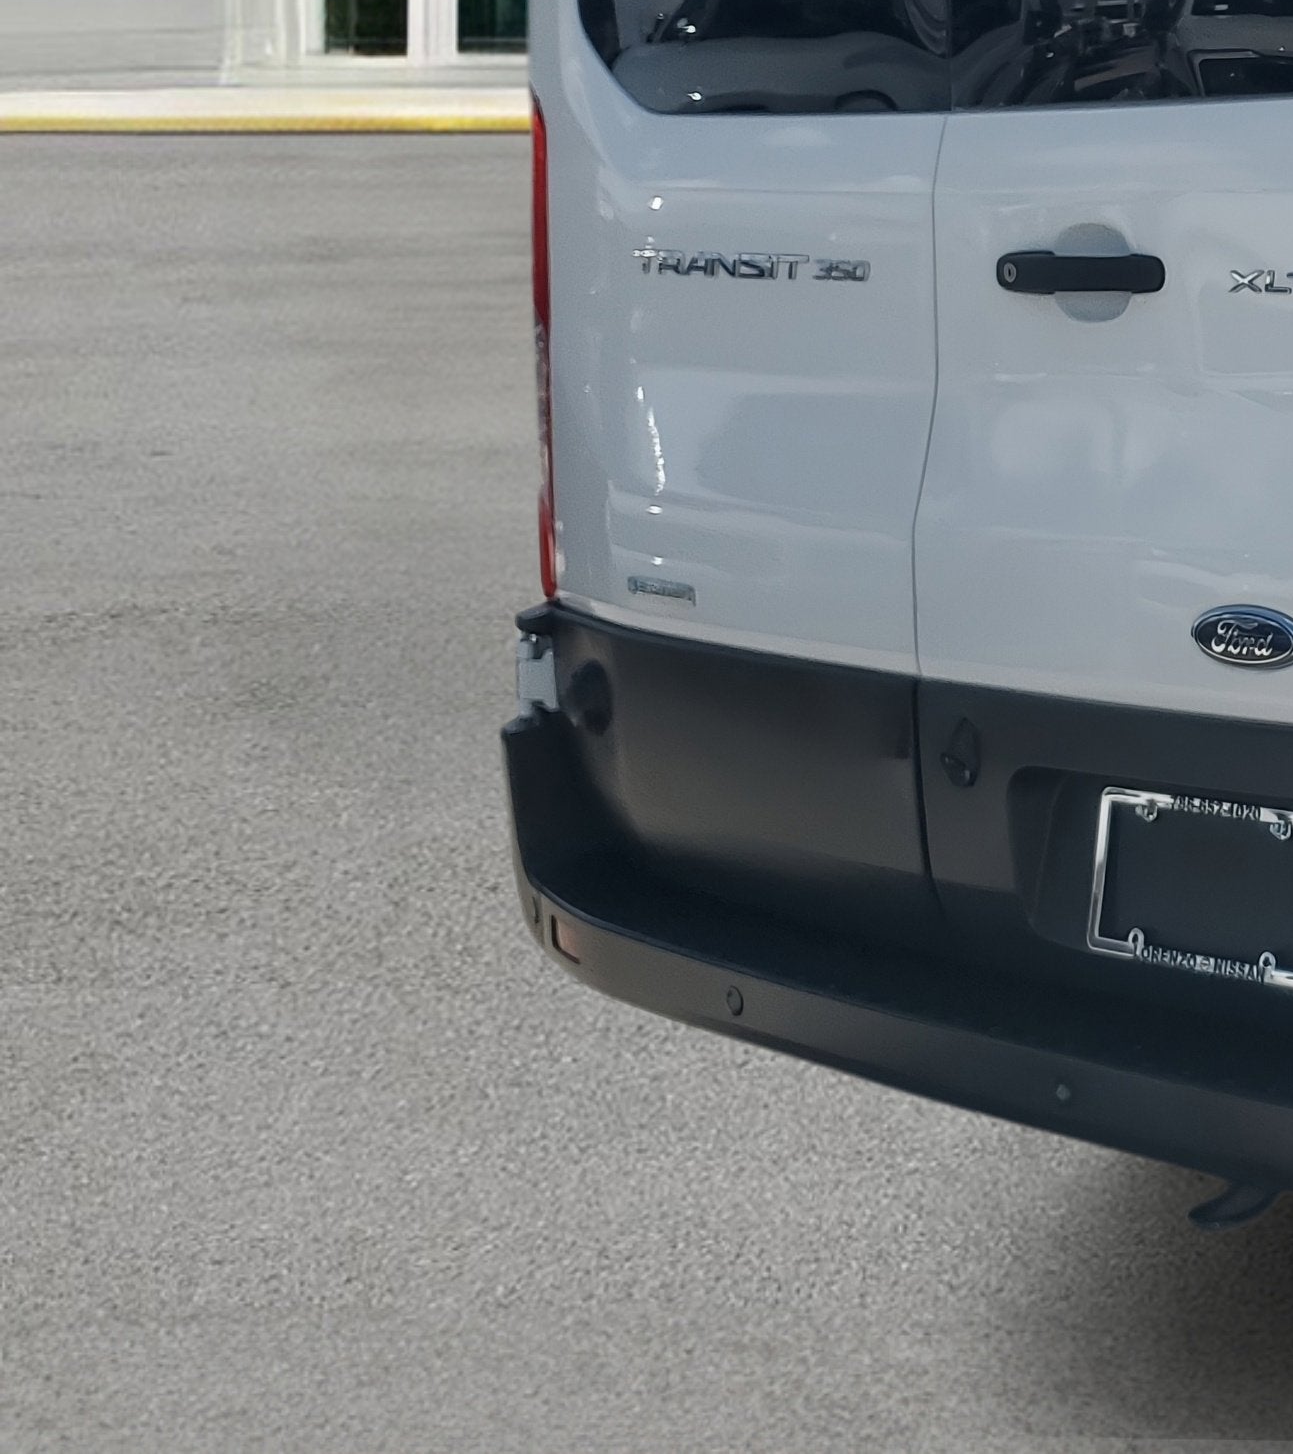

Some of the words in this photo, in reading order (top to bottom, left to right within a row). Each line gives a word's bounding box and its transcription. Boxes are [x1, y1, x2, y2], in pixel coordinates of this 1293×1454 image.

[632, 248, 810, 280] TRANSIT
[813, 259, 871, 282] 350
[1211, 619, 1274, 656] Ford
[1133, 942, 1198, 969] LORENZO
